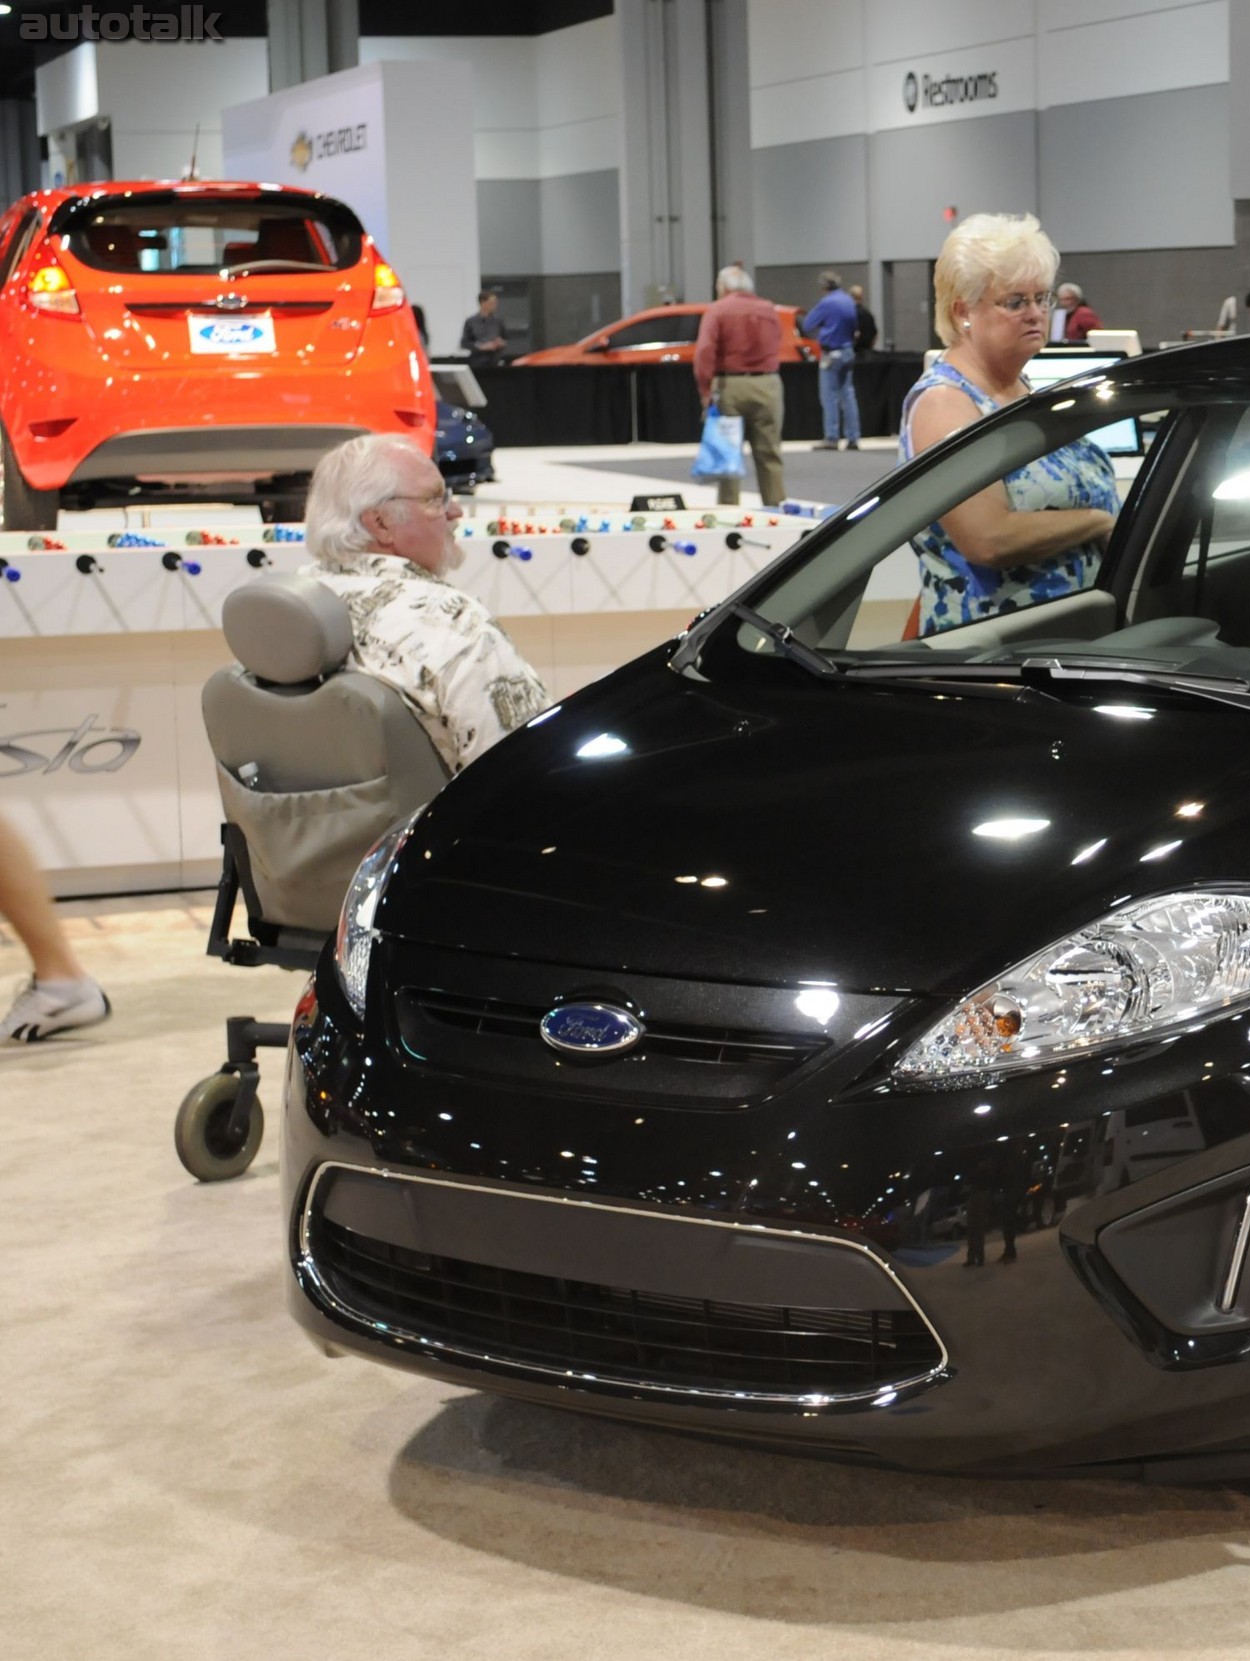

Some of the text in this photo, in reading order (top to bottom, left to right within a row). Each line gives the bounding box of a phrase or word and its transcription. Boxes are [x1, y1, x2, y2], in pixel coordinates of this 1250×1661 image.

[922, 71, 999, 108] Restrooms
[315, 122, 368, 160] CHEVROLET
[209, 323, 256, 344] Ford
[556, 1014, 612, 1043] Ford
